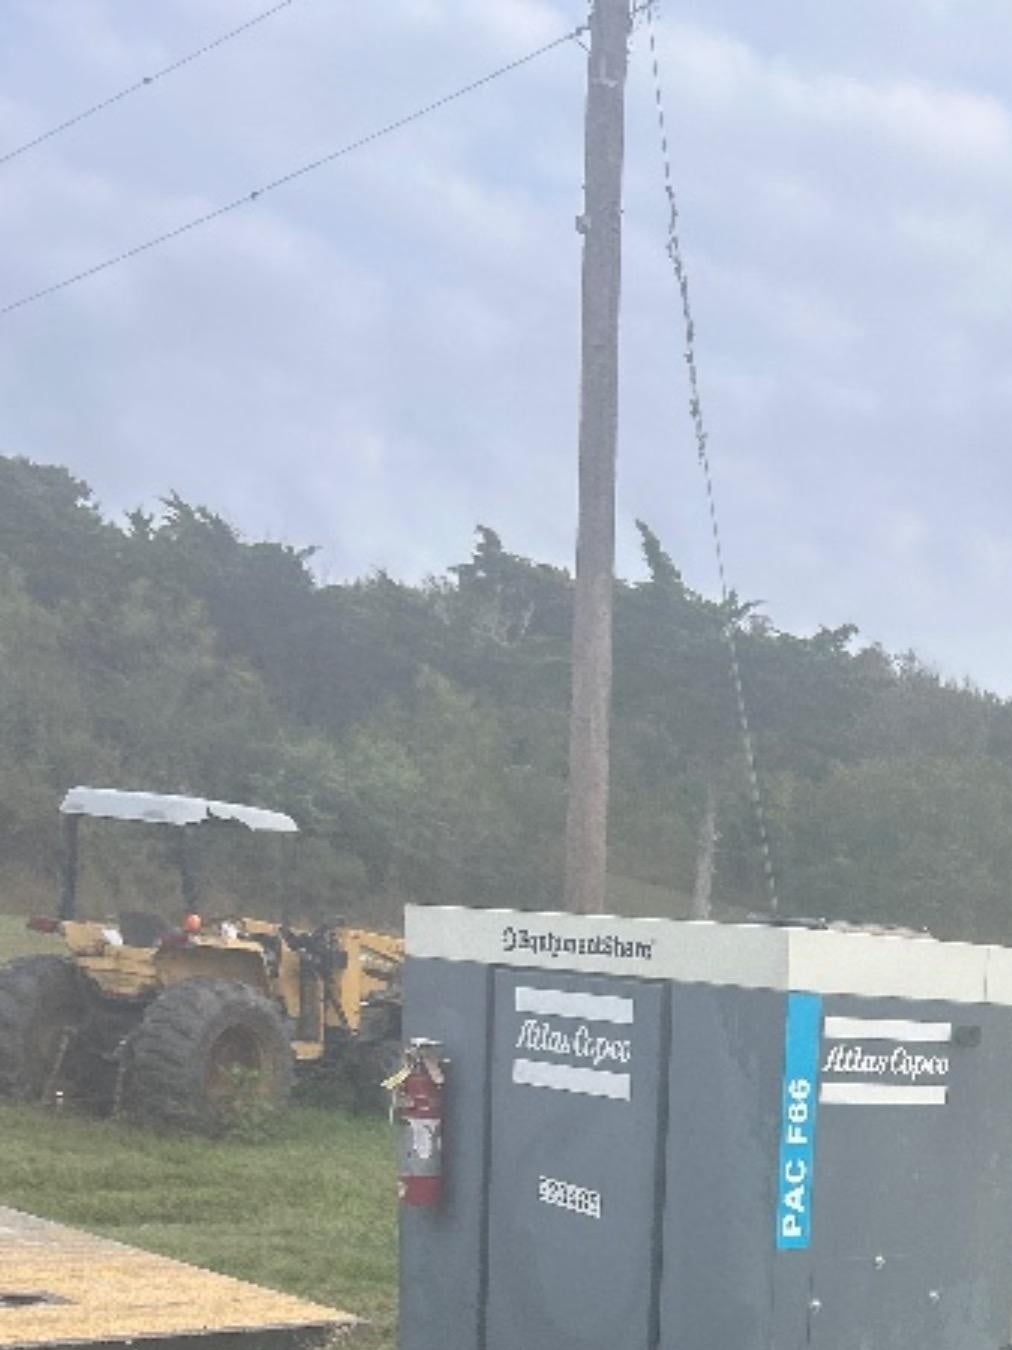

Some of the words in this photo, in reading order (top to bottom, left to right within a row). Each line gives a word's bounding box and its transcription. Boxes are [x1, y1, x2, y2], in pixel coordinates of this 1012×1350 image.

[515, 1019, 571, 1054] Atlas
[573, 1025, 631, 1066] Copco
[821, 1045, 889, 1076] Atlas
[889, 1046, 950, 1081] Copco
[781, 1159, 807, 1238] PAC
